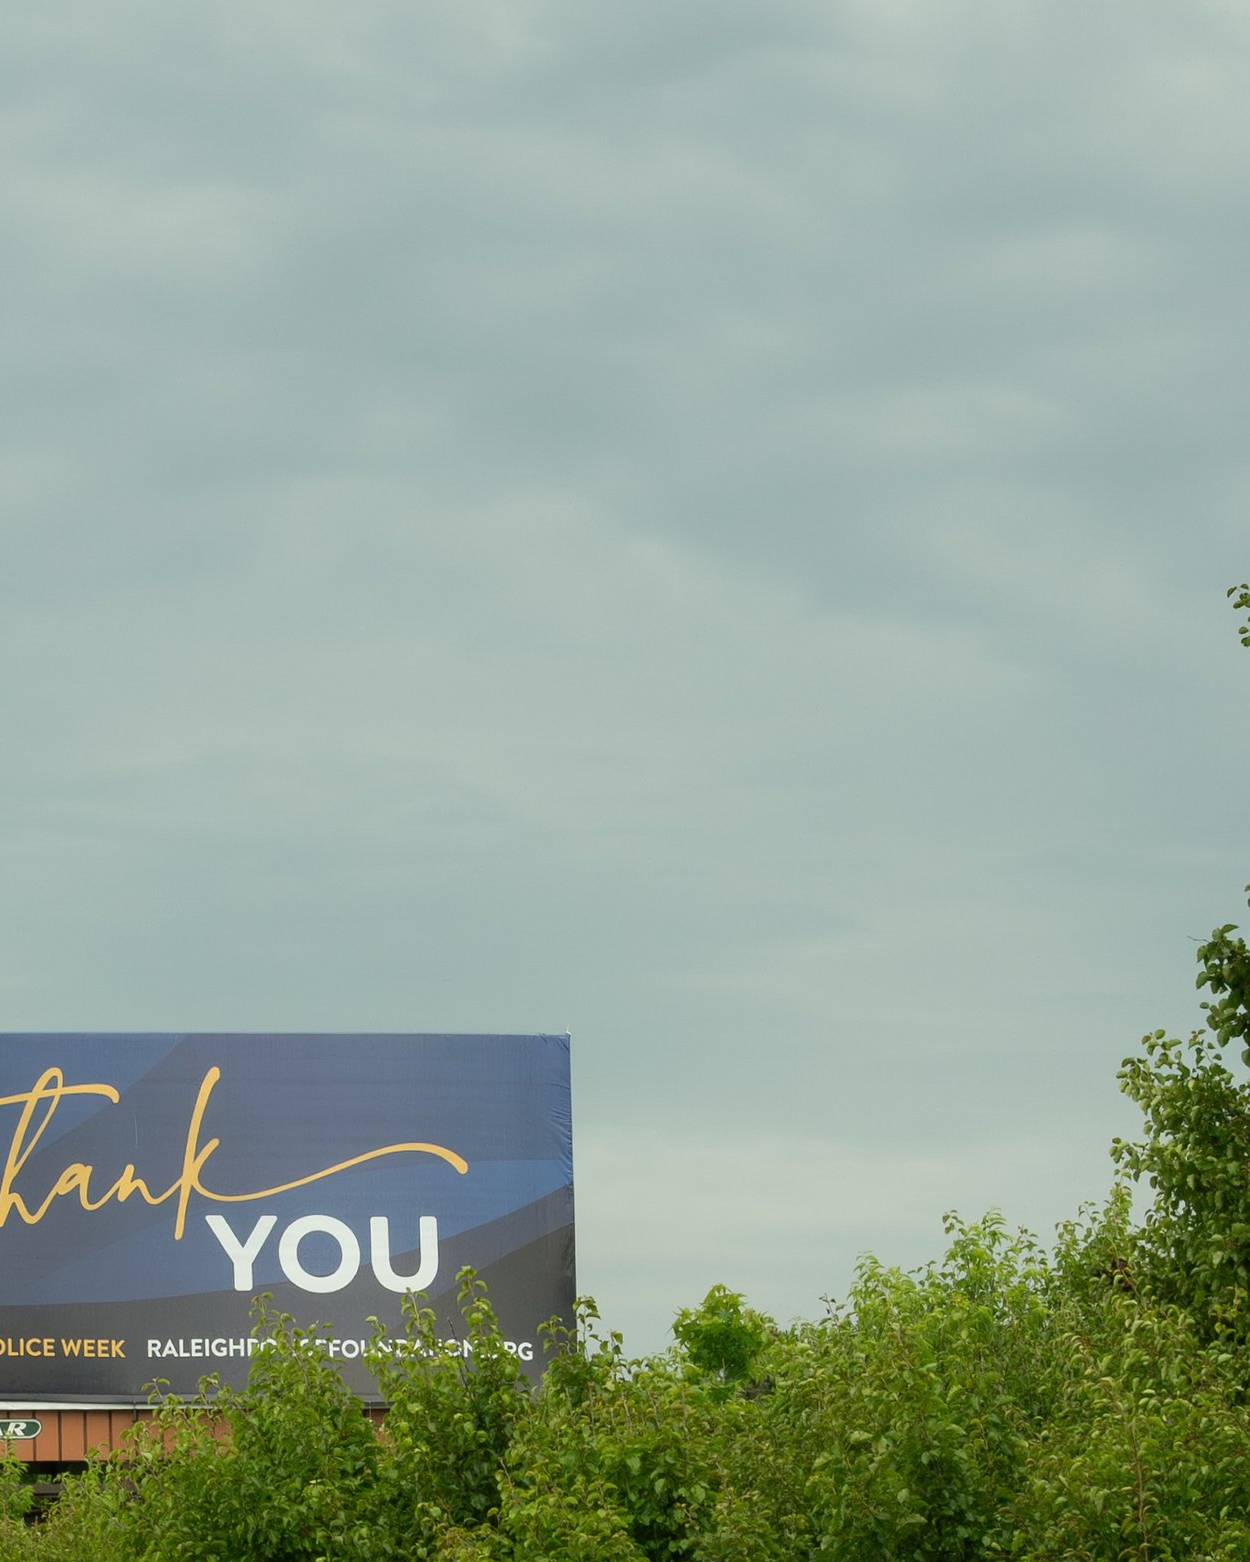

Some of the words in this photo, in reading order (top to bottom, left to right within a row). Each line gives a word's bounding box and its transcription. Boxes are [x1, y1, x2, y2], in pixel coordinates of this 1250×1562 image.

[204, 1214, 439, 1294] YOU
[61, 1338, 125, 1359] WEEK
[147, 1337, 534, 1361] RALEIGHPOFONAON.RG
